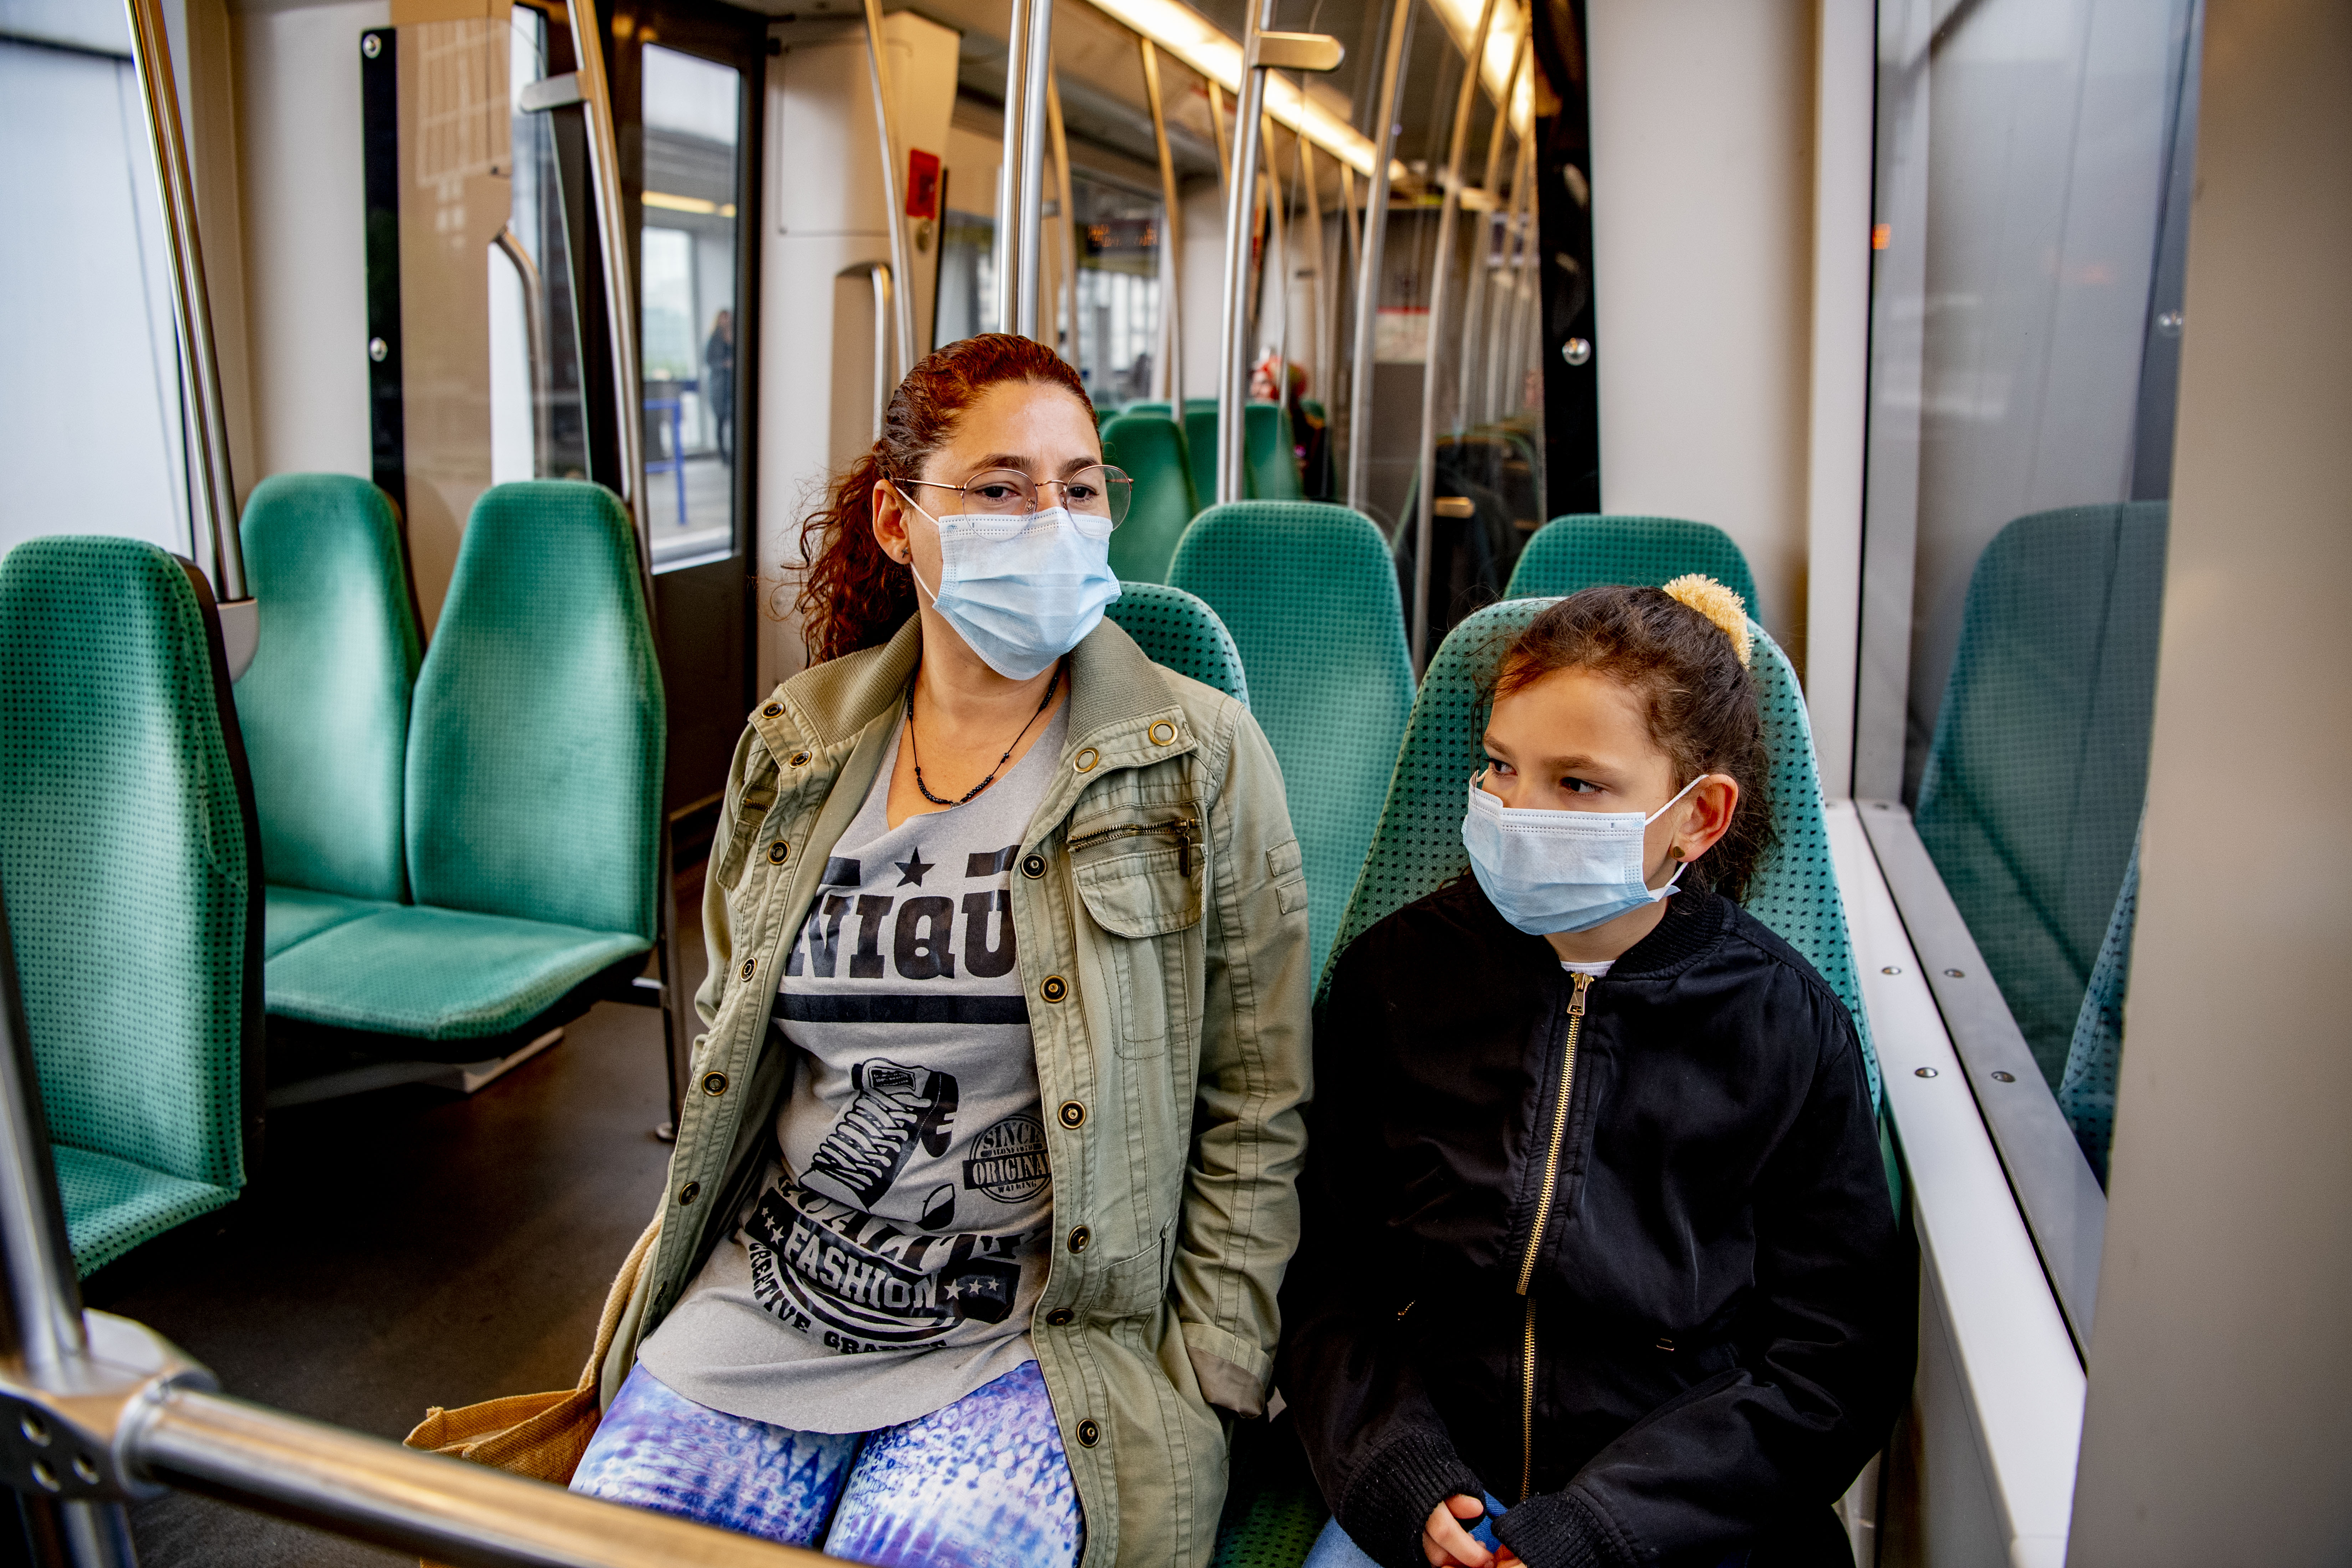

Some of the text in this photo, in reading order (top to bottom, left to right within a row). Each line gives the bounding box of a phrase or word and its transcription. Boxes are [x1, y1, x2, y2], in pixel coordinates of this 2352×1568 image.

[983, 1122, 1041, 1149] SINCE
[749, 1242, 812, 1334] CREATIVE
[784, 1221, 942, 1308] FASHION
